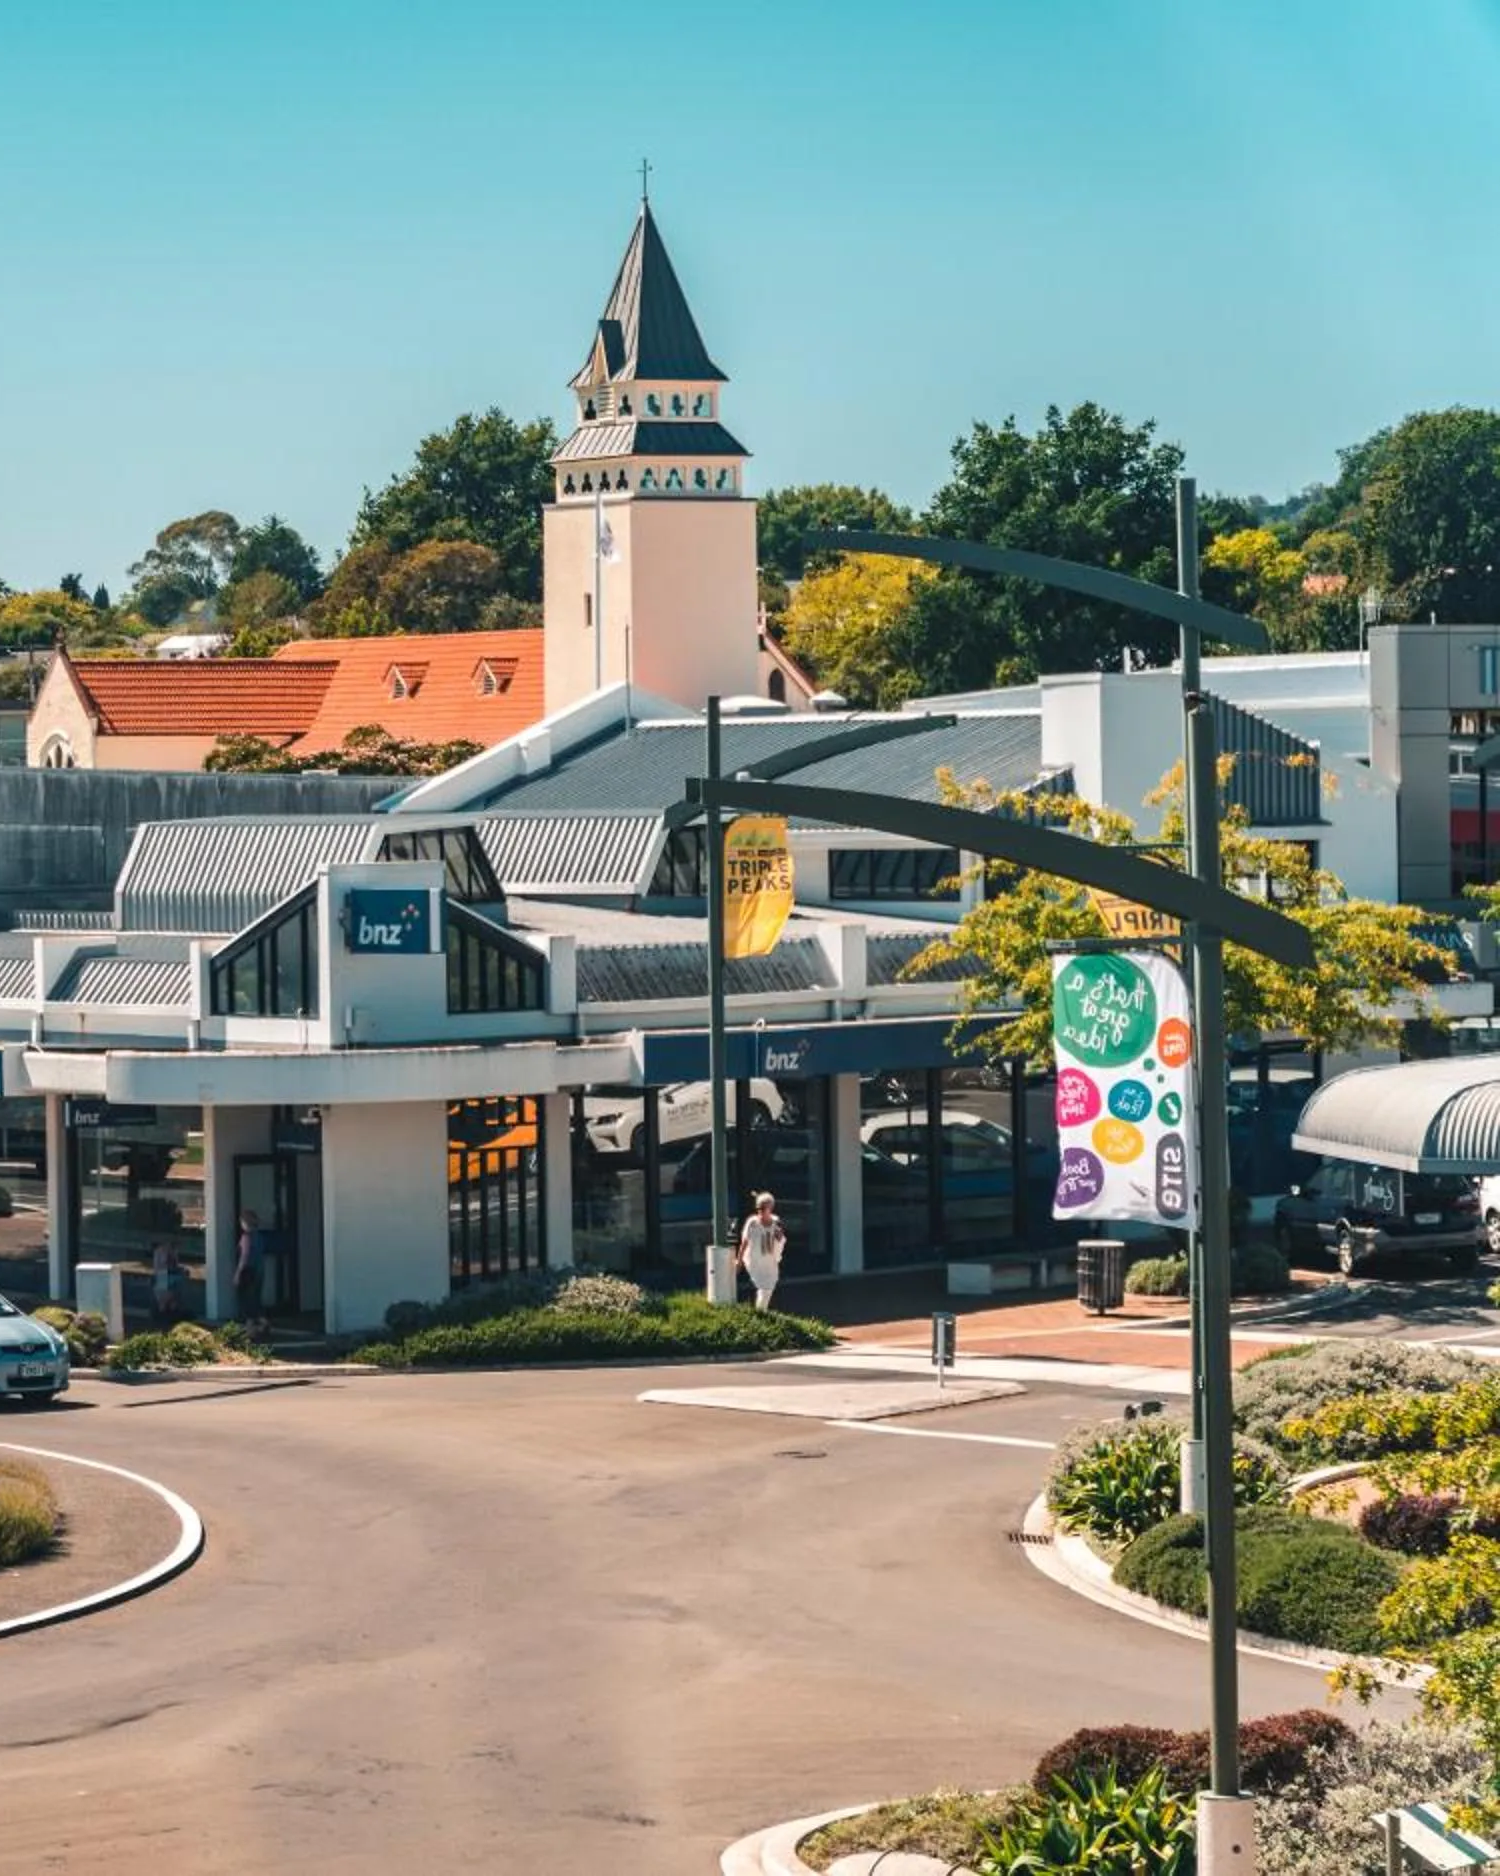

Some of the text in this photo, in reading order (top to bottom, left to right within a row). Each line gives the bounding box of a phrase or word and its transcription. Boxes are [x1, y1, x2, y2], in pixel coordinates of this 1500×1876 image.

[728, 858, 788, 876] TRIPLE
[728, 876, 790, 894] PEAKS
[359, 915, 402, 945] bnz
[765, 1048, 799, 1071] bnz
[76, 1109, 100, 1124] bnz
